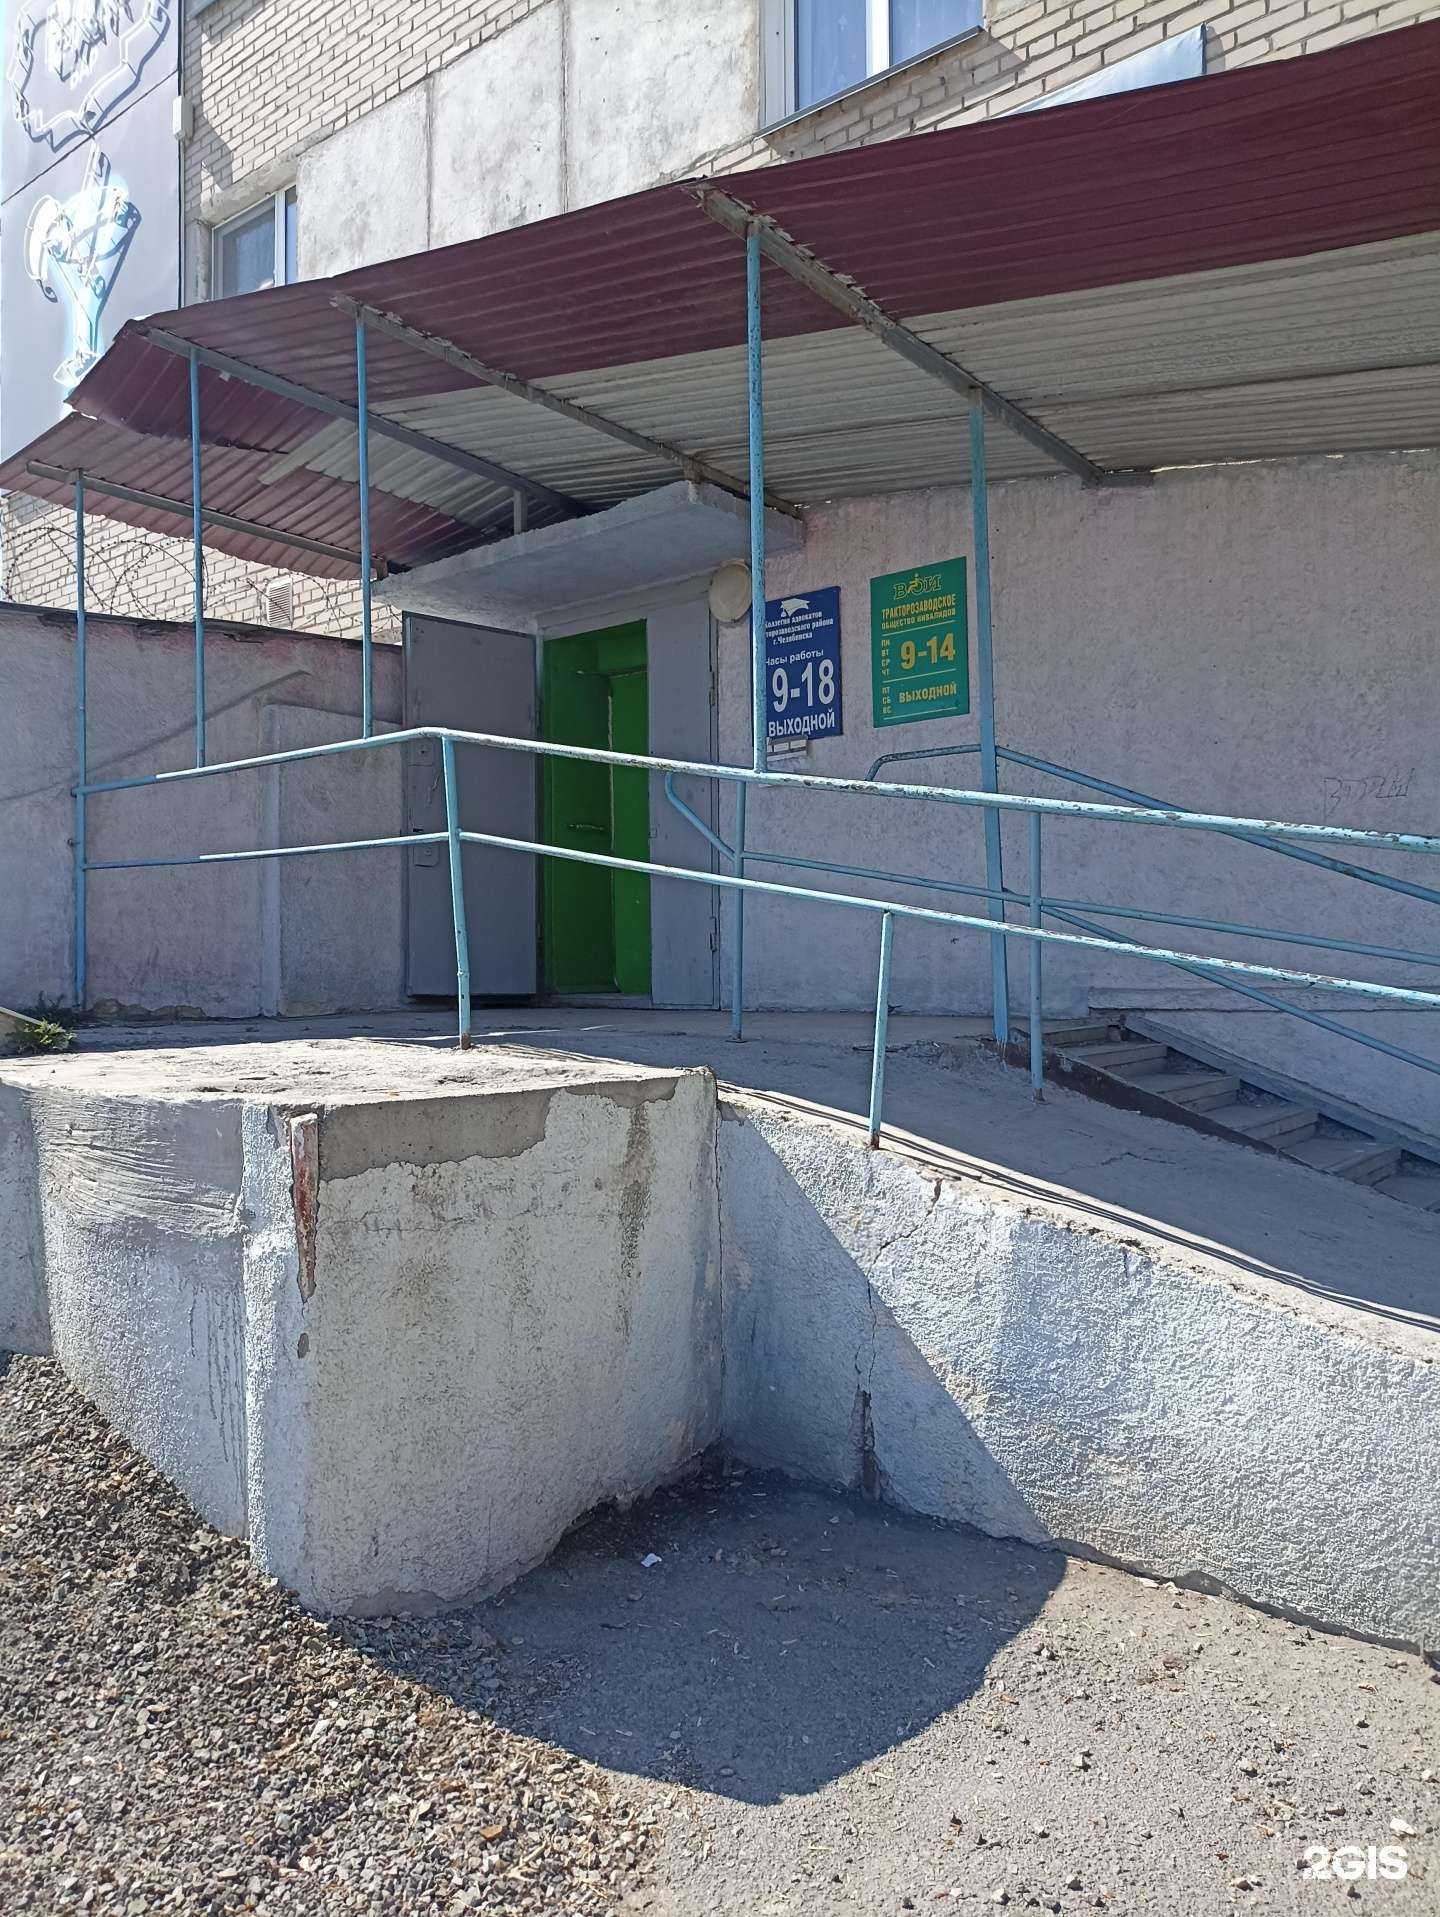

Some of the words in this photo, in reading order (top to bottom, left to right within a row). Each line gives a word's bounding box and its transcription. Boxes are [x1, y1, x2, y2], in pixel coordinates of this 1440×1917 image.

[881, 593, 956, 619] ТРАКТОРОЗАВОДСКОЕ
[811, 618, 834, 630] района
[881, 616, 916, 630] ОБЩЕСТВО
[917, 607, 956, 623] ИНВАЛИДОВ
[789, 649, 824, 664] работы
[901, 632, 956, 670] 9-14
[772, 658, 835, 713] 9-18
[899, 682, 957, 703] ВЫХОДНОЙ
[768, 708, 835, 737] ВЫХОДНОЙ
